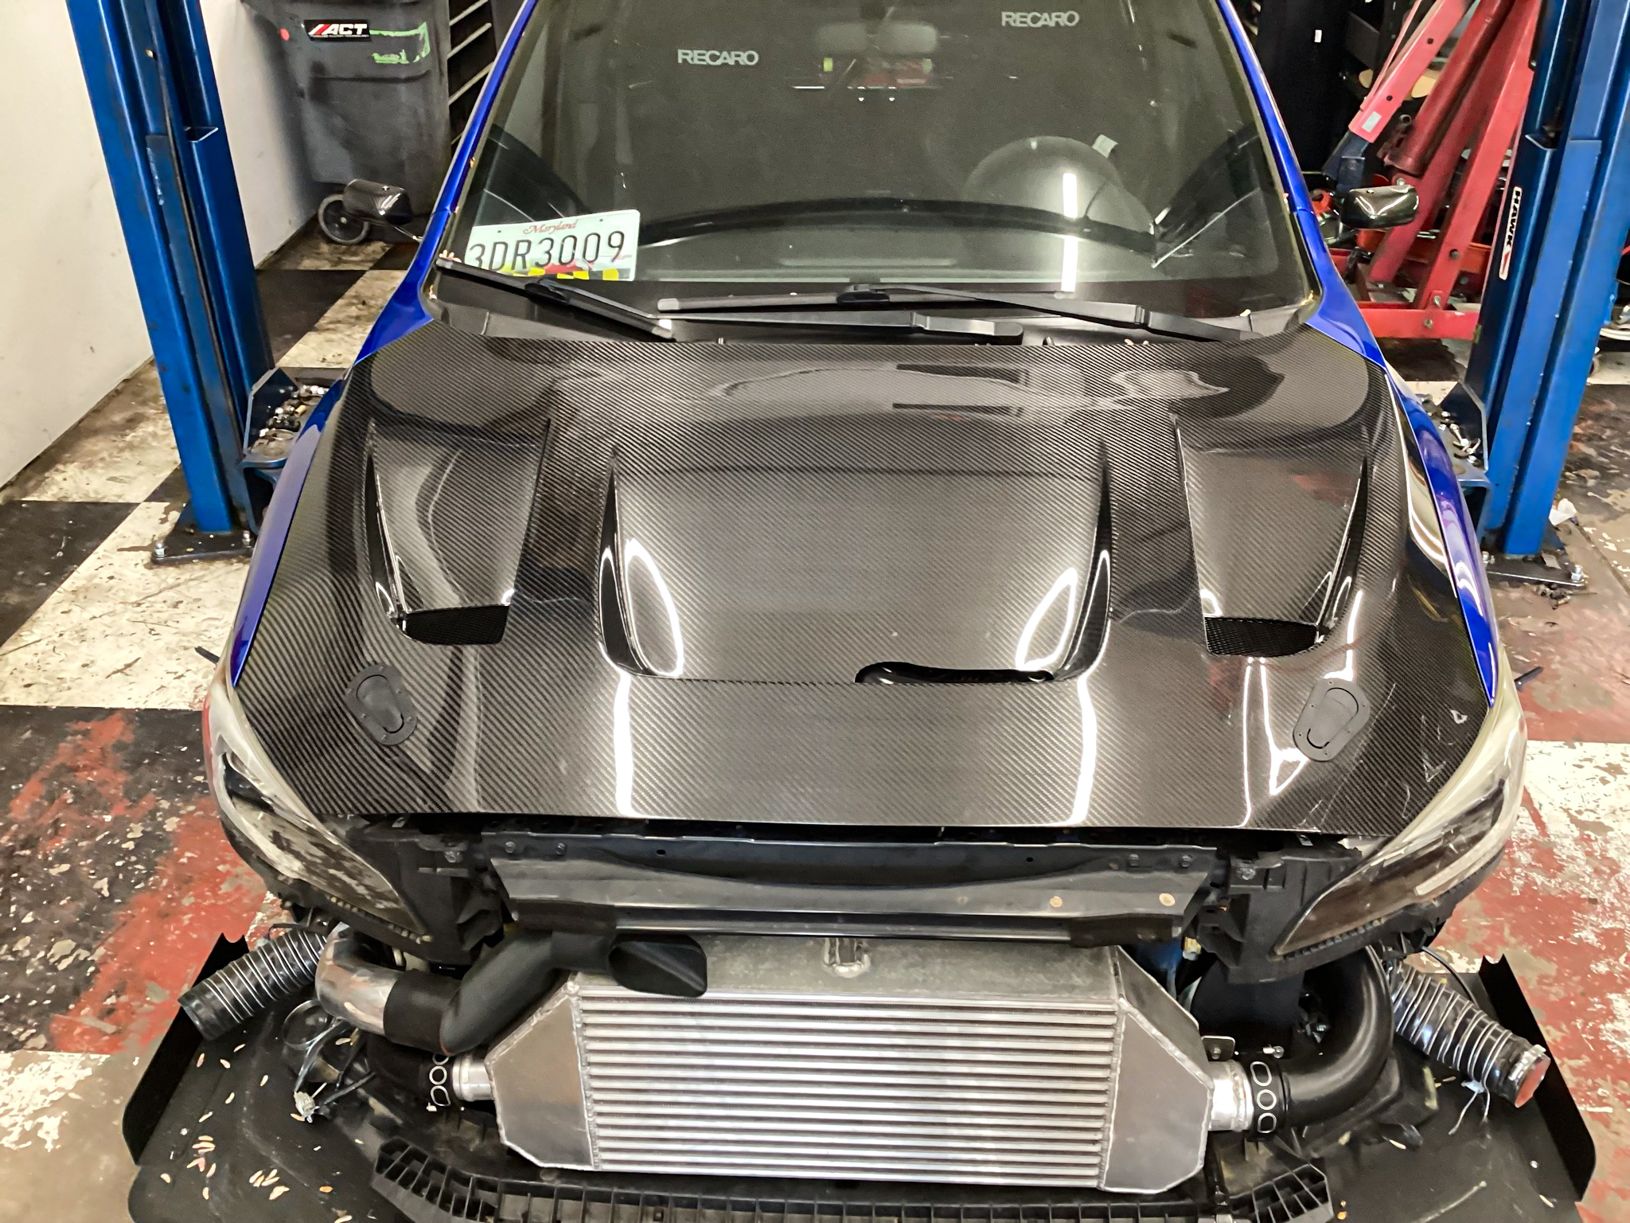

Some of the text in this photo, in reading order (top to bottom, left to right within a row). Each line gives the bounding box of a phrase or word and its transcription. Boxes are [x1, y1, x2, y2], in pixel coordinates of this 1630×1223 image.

[1001, 11, 1080, 27] RECARO
[318, 23, 368, 35] ACT
[677, 49, 759, 65] RECARO
[1506, 190, 1521, 247] HAWK
[523, 220, 579, 234] Maryland
[469, 231, 625, 271] 3DR3009
